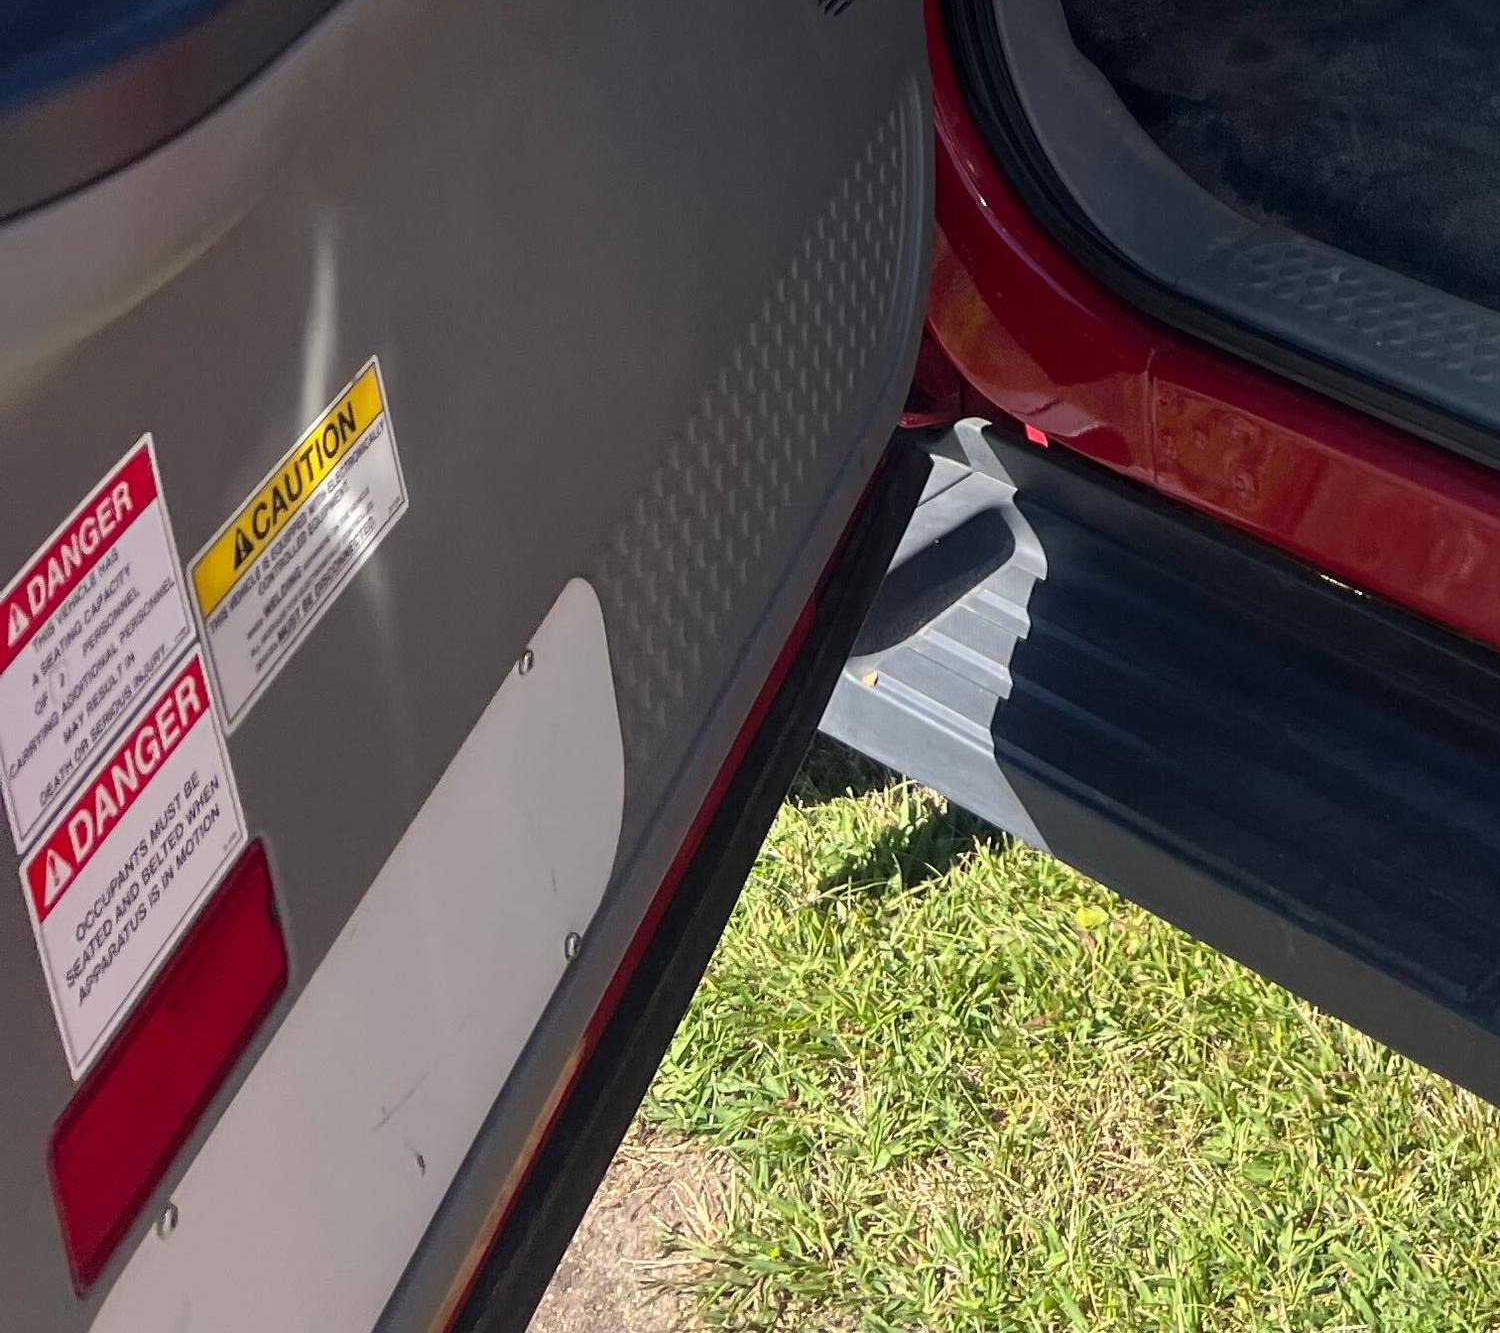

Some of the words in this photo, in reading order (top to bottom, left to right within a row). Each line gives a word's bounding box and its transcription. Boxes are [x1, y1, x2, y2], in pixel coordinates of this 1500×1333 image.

[248, 399, 357, 546] CAUTION
[24, 475, 135, 620] DANGER
[32, 618, 55, 653] THIS
[55, 570, 97, 627] VEHICLE
[97, 545, 119, 578] HAS
[6, 709, 59, 782] CARRYING
[59, 638, 118, 717] ADDITIONAL
[117, 570, 175, 648] PERSONNEL
[29, 668, 40, 689] A
[39, 618, 83, 677] SEATING
[82, 561, 131, 627] CAPACITY
[32, 689, 50, 719] OF
[81, 581, 140, 659] PERSONNEL
[62, 710, 85, 745] MAY
[85, 663, 123, 717] RESULT
[123, 648, 136, 671] IN
[38, 756, 74, 808] DEATH
[72, 736, 89, 765] OR
[89, 682, 133, 745] SERIOUS
[64, 668, 203, 867] DANGER
[64, 914, 114, 991] SEATED
[112, 877, 141, 925] AND
[140, 818, 185, 888] BELTED
[184, 772, 219, 828] WHEN
[73, 835, 149, 945] OCCUPANTS
[147, 790, 183, 846] MUST
[181, 767, 200, 801] BE
[76, 899, 148, 1006] APPARATUS
[147, 881, 161, 909] IS
[160, 862, 174, 890] IN
[173, 800, 220, 872] MOTION
